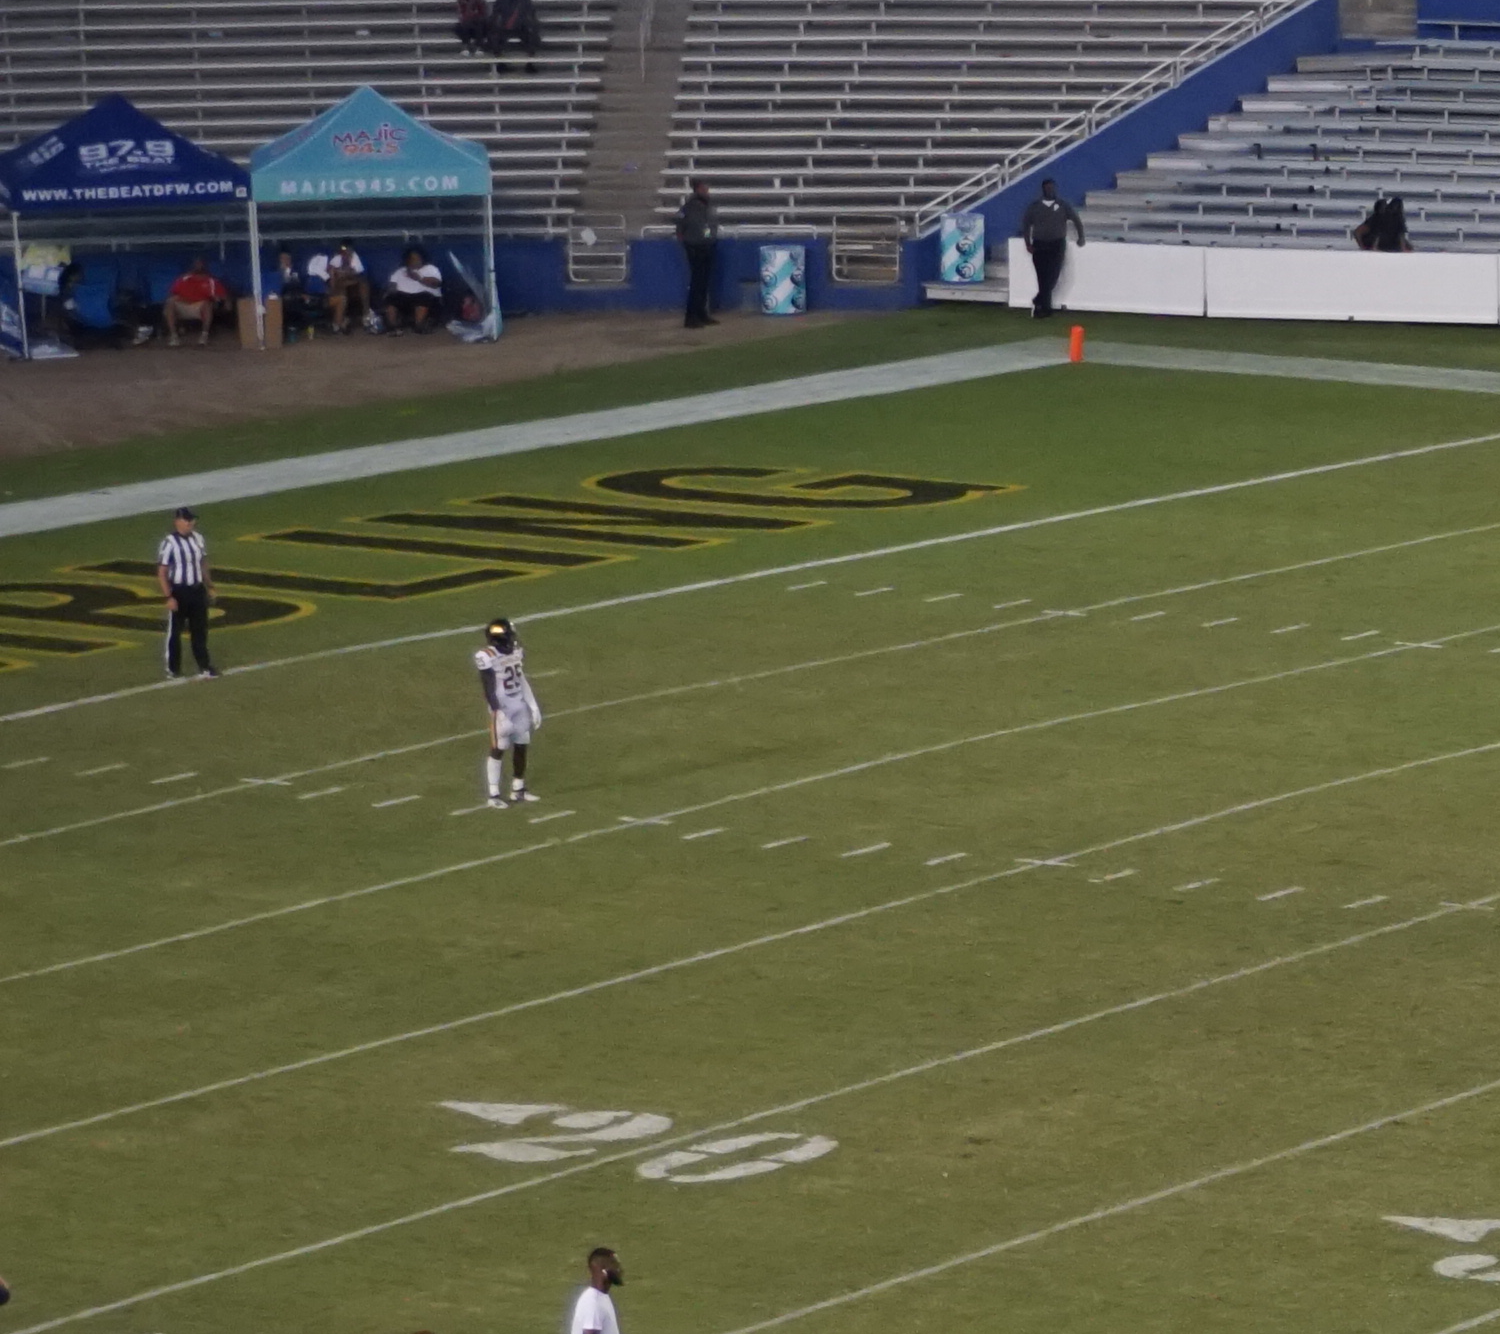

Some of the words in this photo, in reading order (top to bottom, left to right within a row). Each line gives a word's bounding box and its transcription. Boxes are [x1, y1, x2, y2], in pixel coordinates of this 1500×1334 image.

[79, 139, 175, 162] 97.9
[22, 180, 233, 201] WWW.THEBEATDFW.COM
[280, 175, 460, 196] MAJIC945.COM
